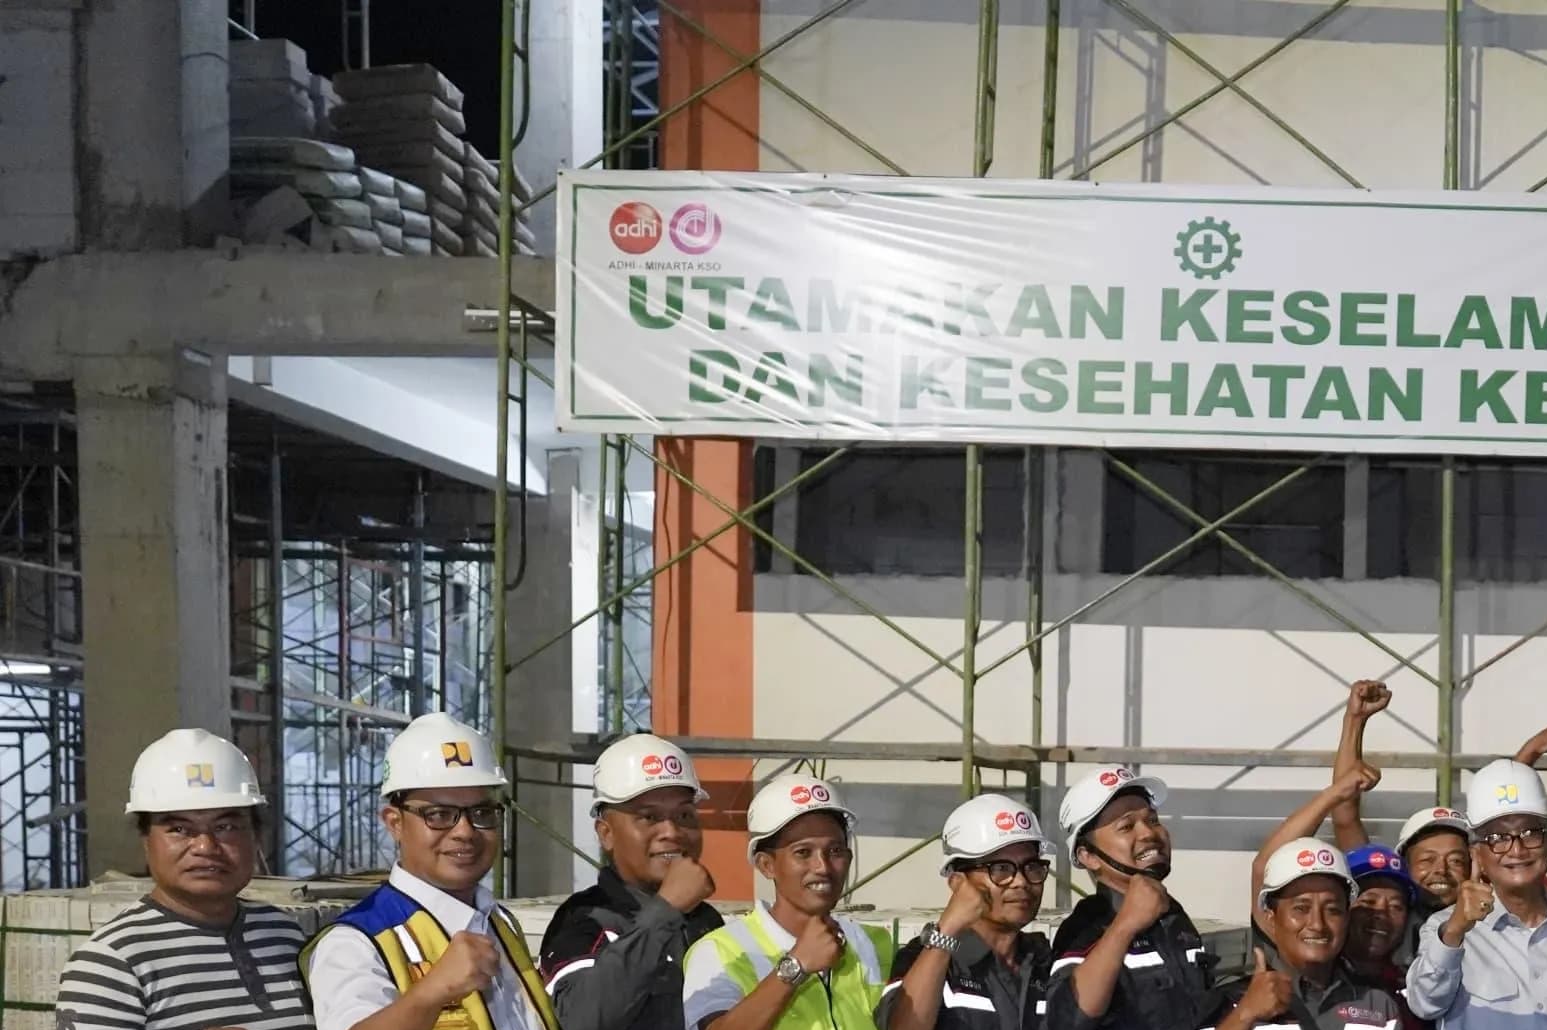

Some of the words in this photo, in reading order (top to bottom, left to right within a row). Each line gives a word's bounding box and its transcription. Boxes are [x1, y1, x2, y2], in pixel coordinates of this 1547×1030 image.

[614, 216, 658, 238] adhi
[608, 260, 636, 271] ADHI
[645, 260, 694, 272] MINARTA
[696, 262, 721, 272] KSO
[689, 347, 863, 407] DAN
[900, 355, 1424, 422] KESEHATAN
